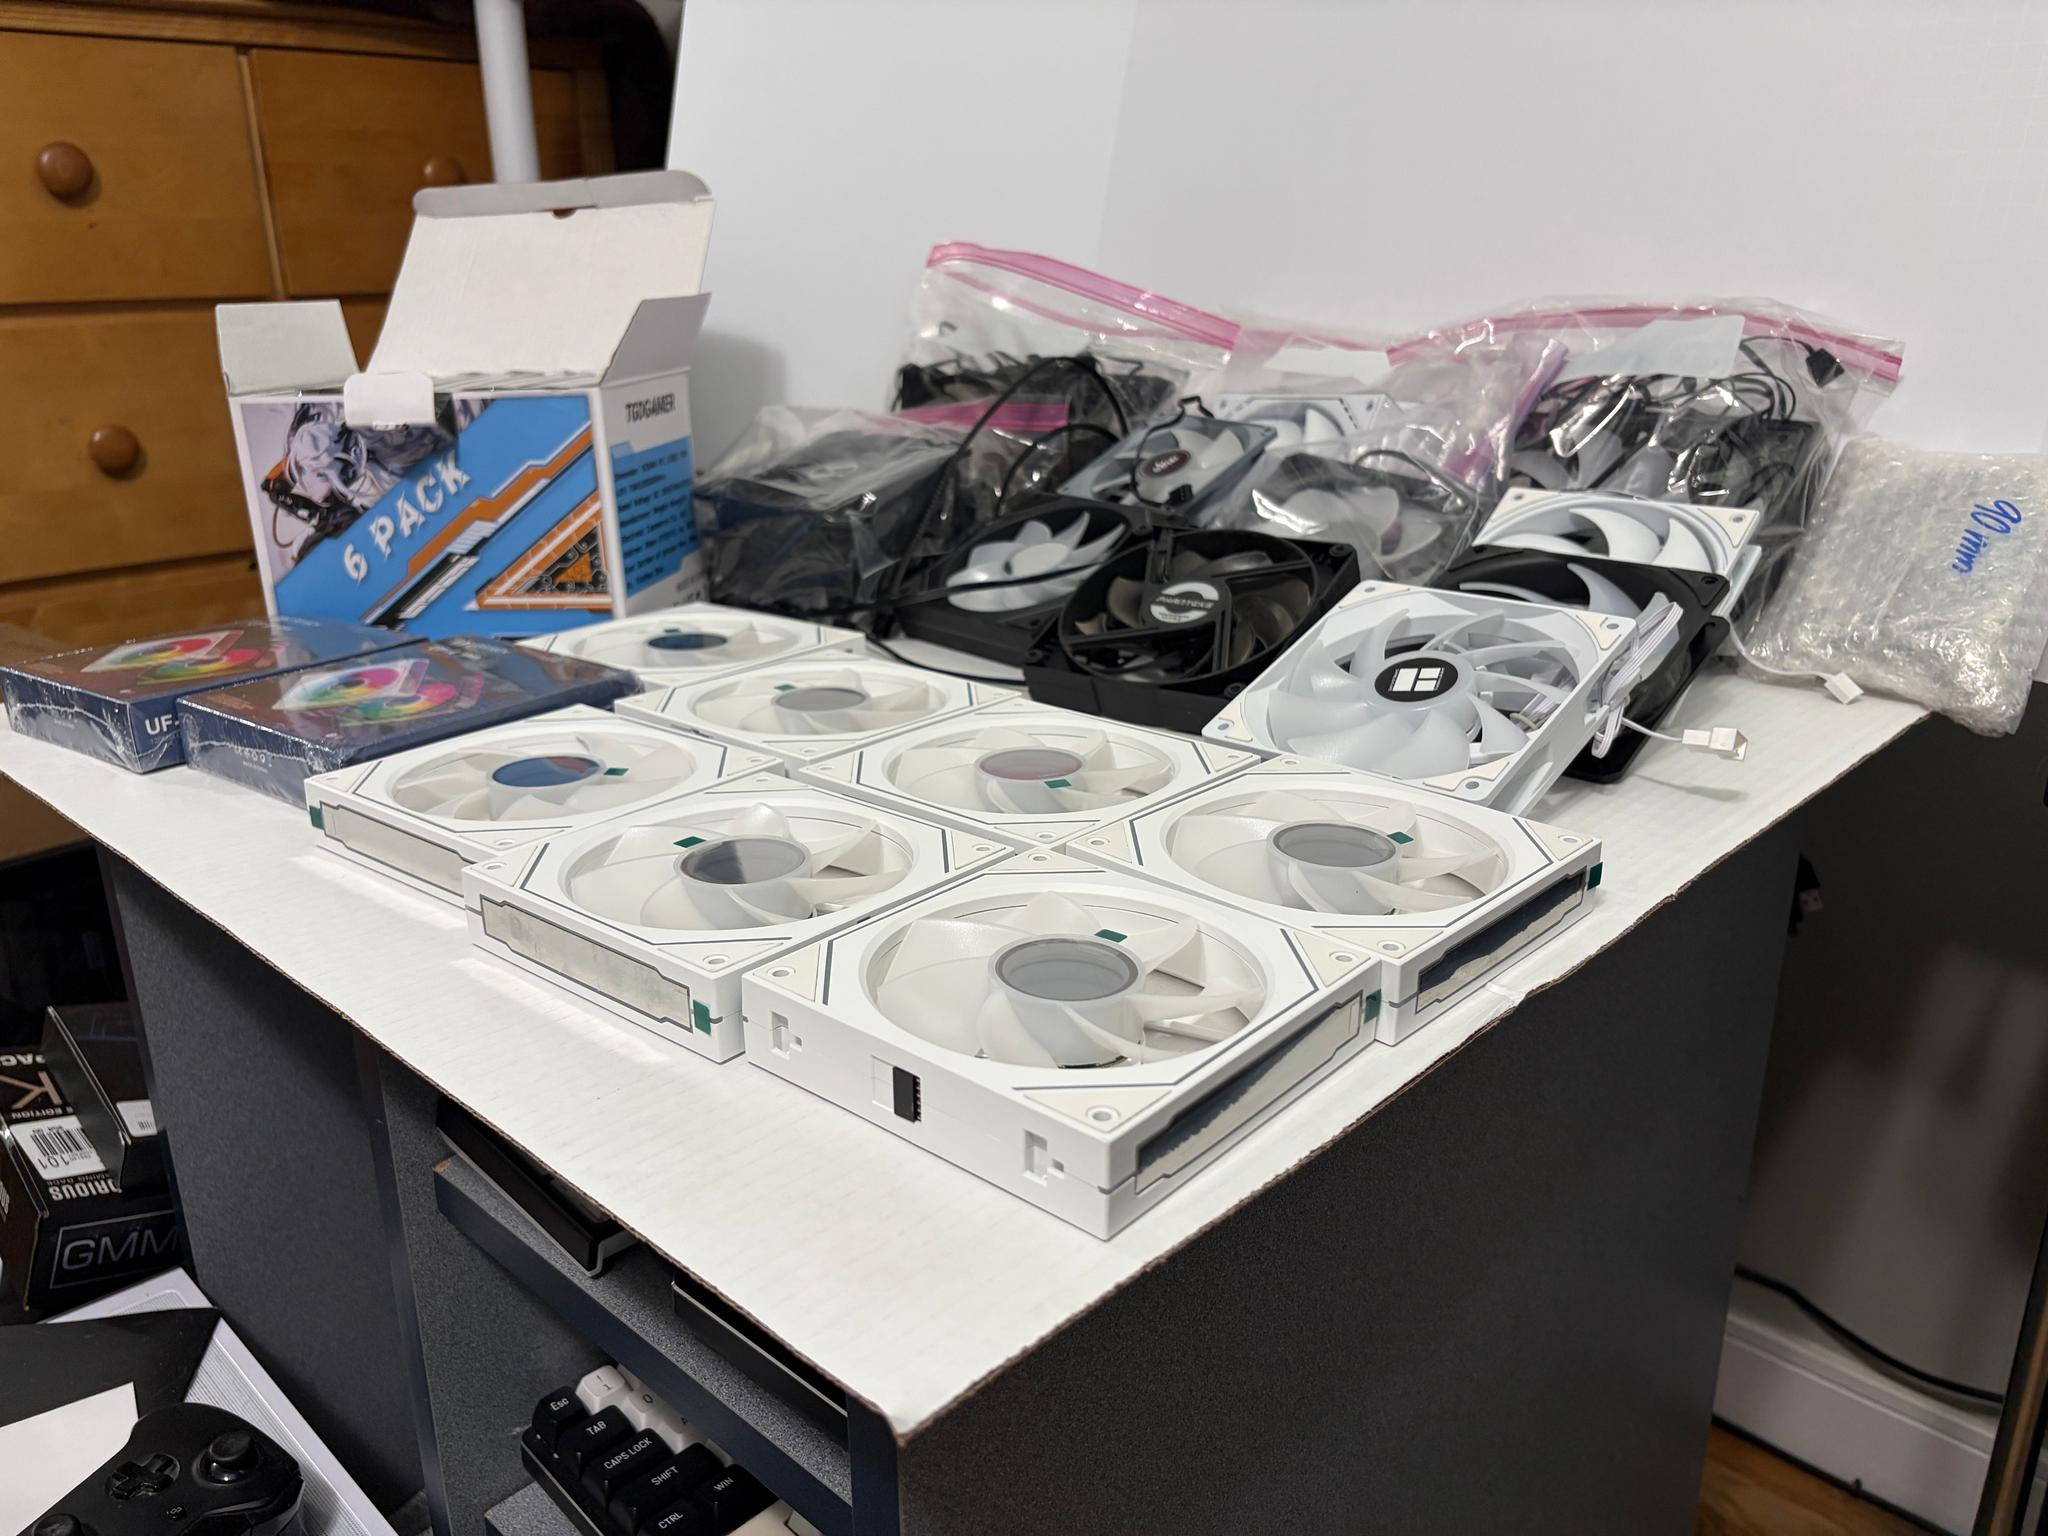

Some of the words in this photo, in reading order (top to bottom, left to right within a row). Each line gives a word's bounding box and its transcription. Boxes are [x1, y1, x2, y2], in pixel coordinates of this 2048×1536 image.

[625, 393, 676, 423] TGDGAMER
[344, 543, 368, 582] 6
[369, 450, 471, 560] PACK
[550, 1397, 570, 1412] Esc
[584, 1420, 608, 1436] TAB
[603, 1451, 630, 1470] CAPS
[628, 1437, 653, 1456] LOCK
[651, 1465, 680, 1486] SHIFT
[713, 1476, 735, 1492] WIN
[657, 1511, 684, 1529] CTRL
